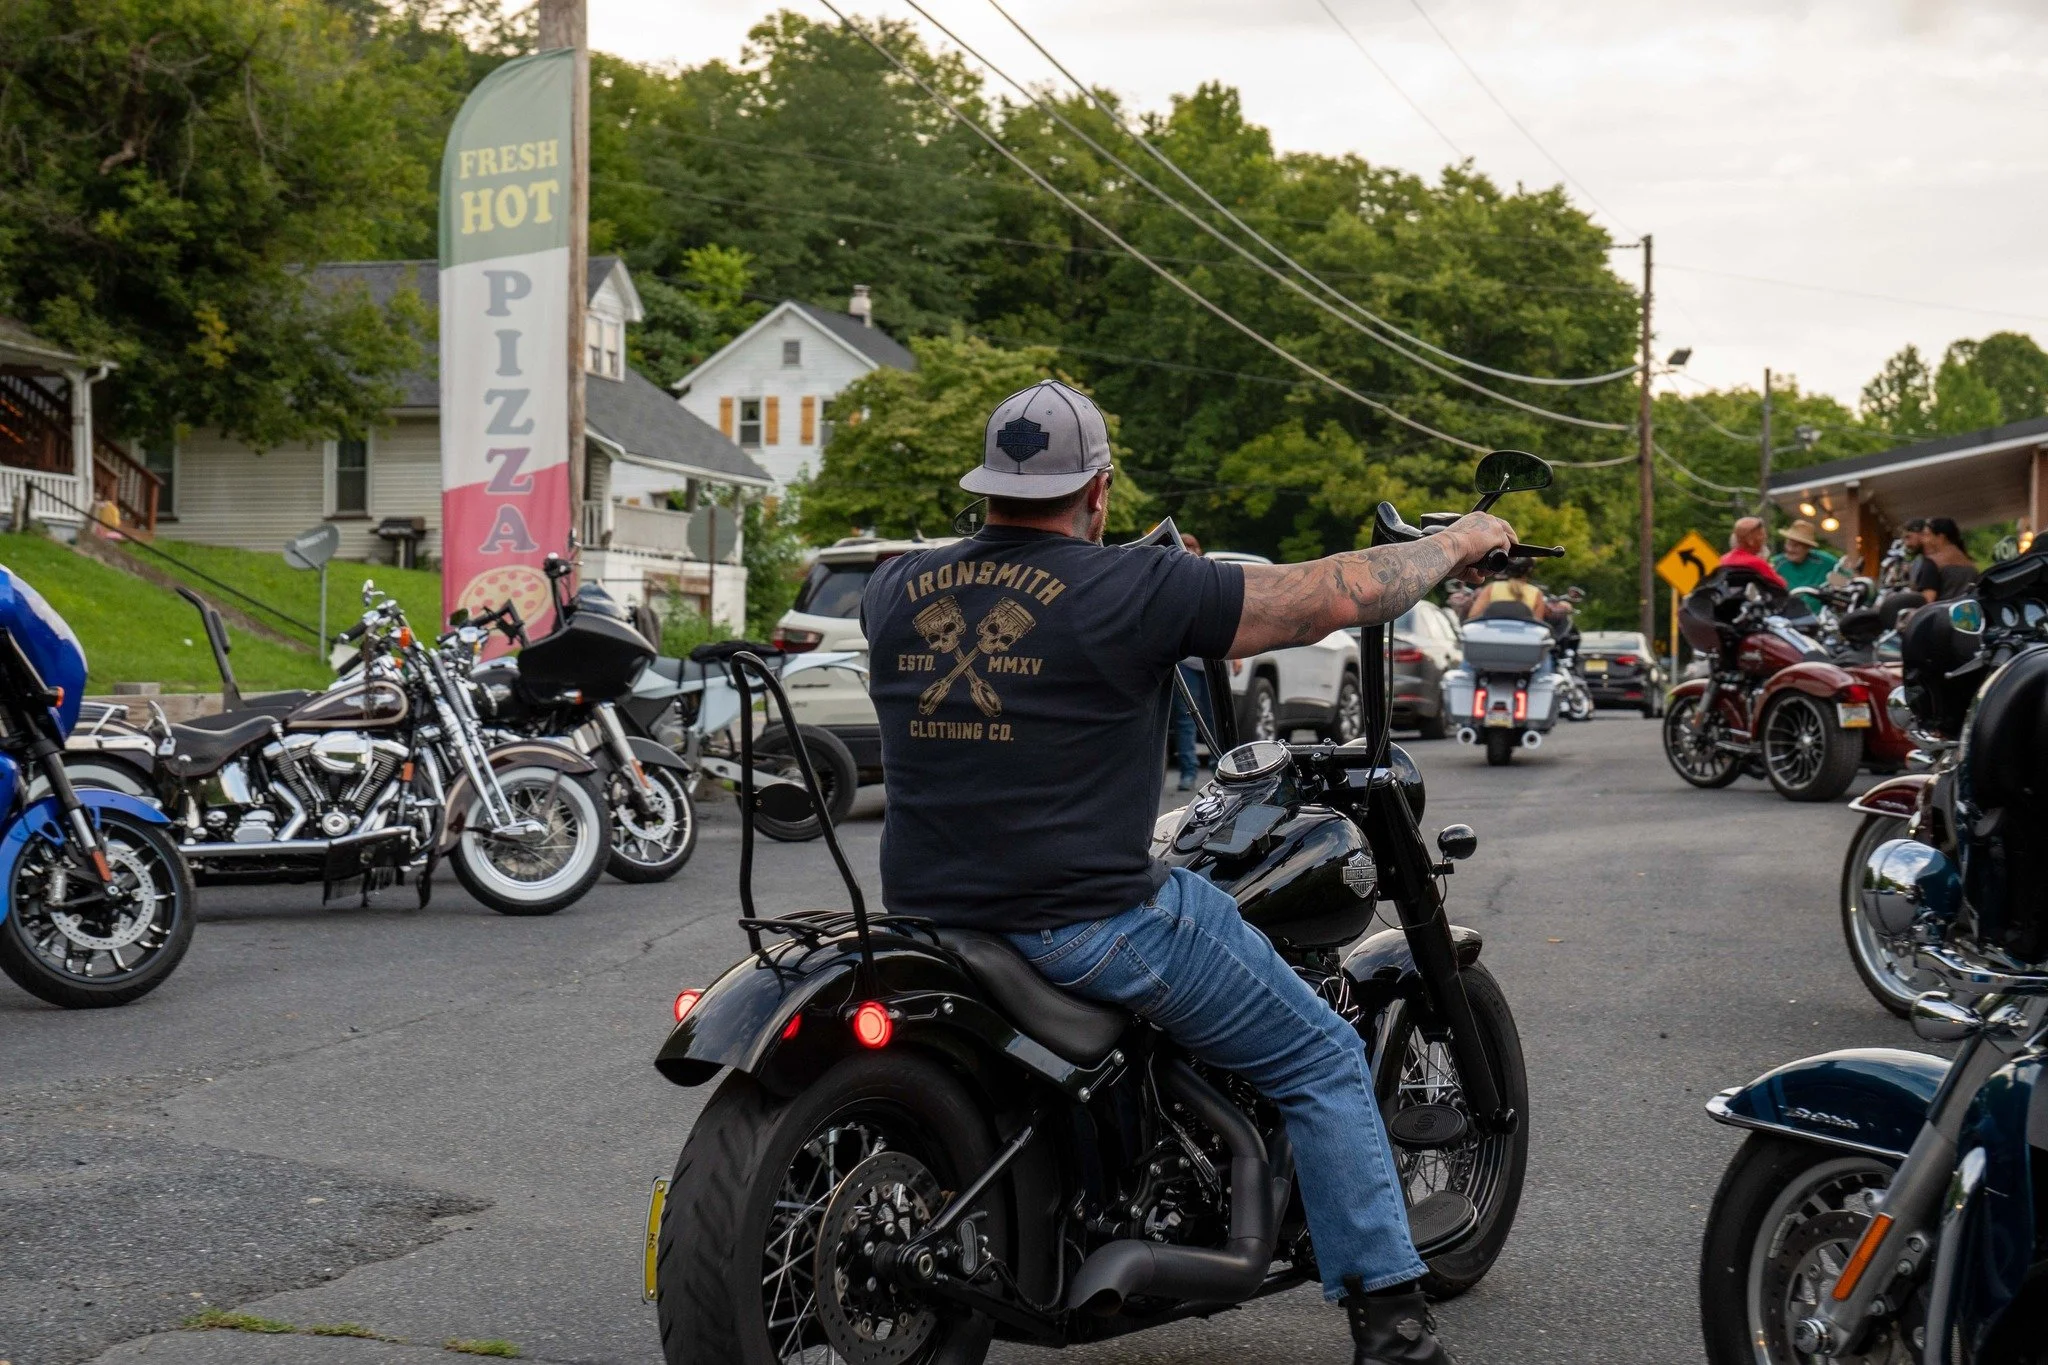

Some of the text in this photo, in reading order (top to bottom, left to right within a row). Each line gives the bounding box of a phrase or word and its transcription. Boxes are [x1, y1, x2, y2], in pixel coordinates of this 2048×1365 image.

[459, 139, 559, 180] FRESH
[460, 178, 560, 235] HOT
[479, 269, 540, 554] PIZZA
[906, 560, 1067, 606] IRONSMITH
[898, 654, 1043, 675] ESTD. MMXV
[910, 720, 1015, 741] CLOTHING CO.
